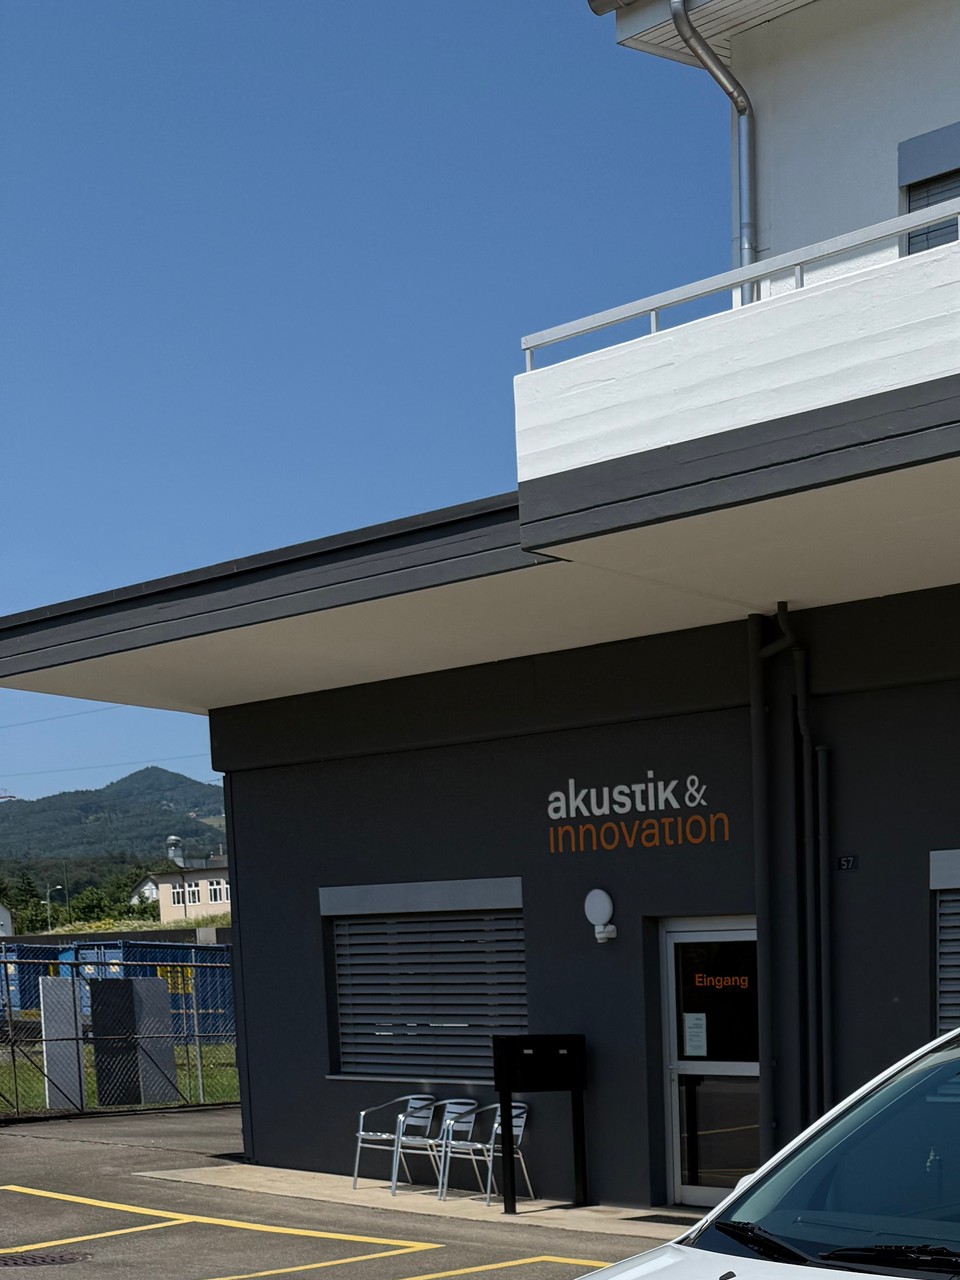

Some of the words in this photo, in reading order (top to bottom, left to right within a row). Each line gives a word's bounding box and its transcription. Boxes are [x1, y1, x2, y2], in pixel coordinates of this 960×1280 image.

[547, 770, 681, 820] akustik
[684, 775, 708, 808] &
[549, 812, 730, 853] innovation
[695, 973, 749, 989] Eingang
